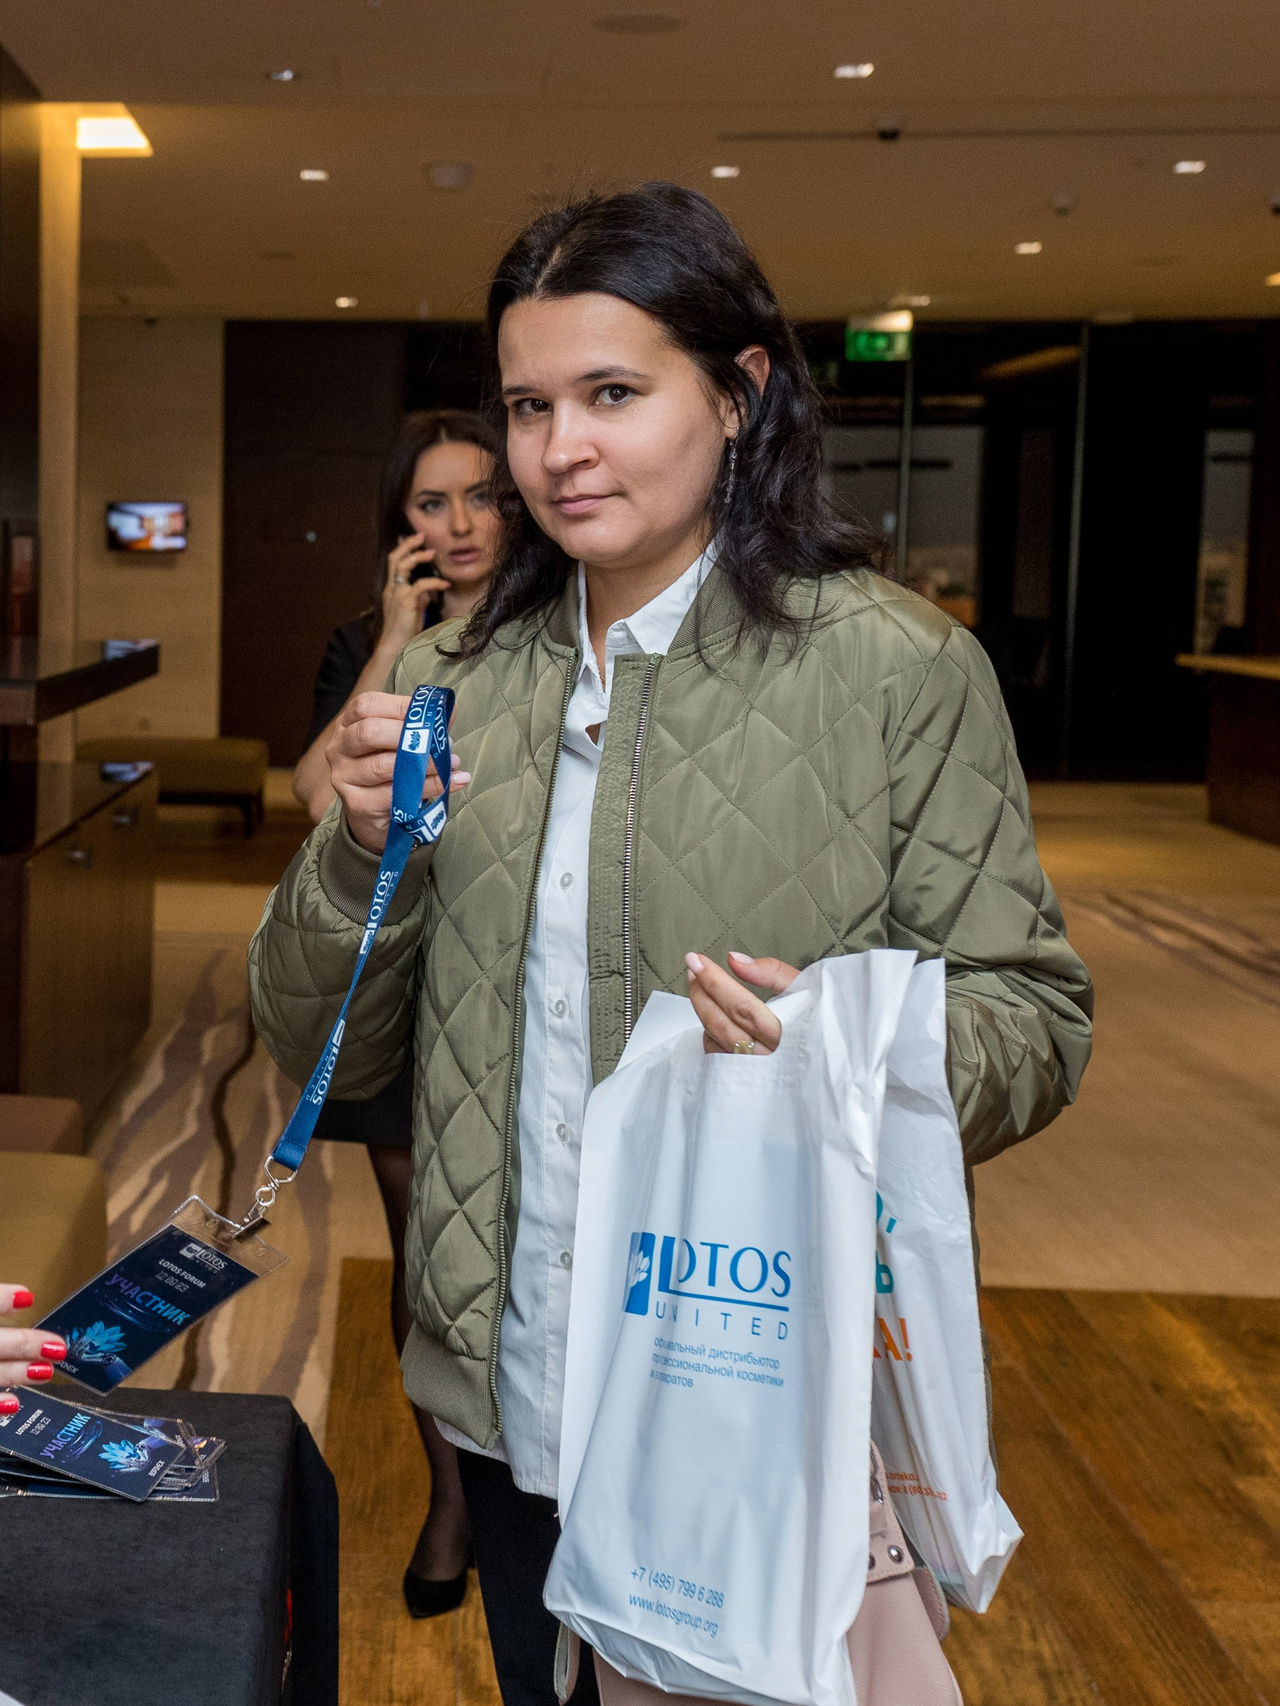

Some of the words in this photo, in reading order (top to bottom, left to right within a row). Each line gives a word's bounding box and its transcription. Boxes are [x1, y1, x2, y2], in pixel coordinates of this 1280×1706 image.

[406, 686, 434, 728] LOTOS
[367, 870, 393, 928] LOTOS
[312, 1046, 339, 1106] LOTOS
[158, 1259, 183, 1275] LOTOS
[180, 1270, 207, 1289] FORUM
[195, 1248, 228, 1270] LOTOS
[105, 1273, 192, 1327] УЧАСТНИК
[655, 1301, 789, 1340] UNITED
[40, 1412, 91, 1460] УЧАСТНИК
[631, 1566, 646, 1582] +7
[648, 1569, 675, 1595] (495)
[678, 1578, 697, 1599] 799
[697, 1585, 706, 1602] 6
